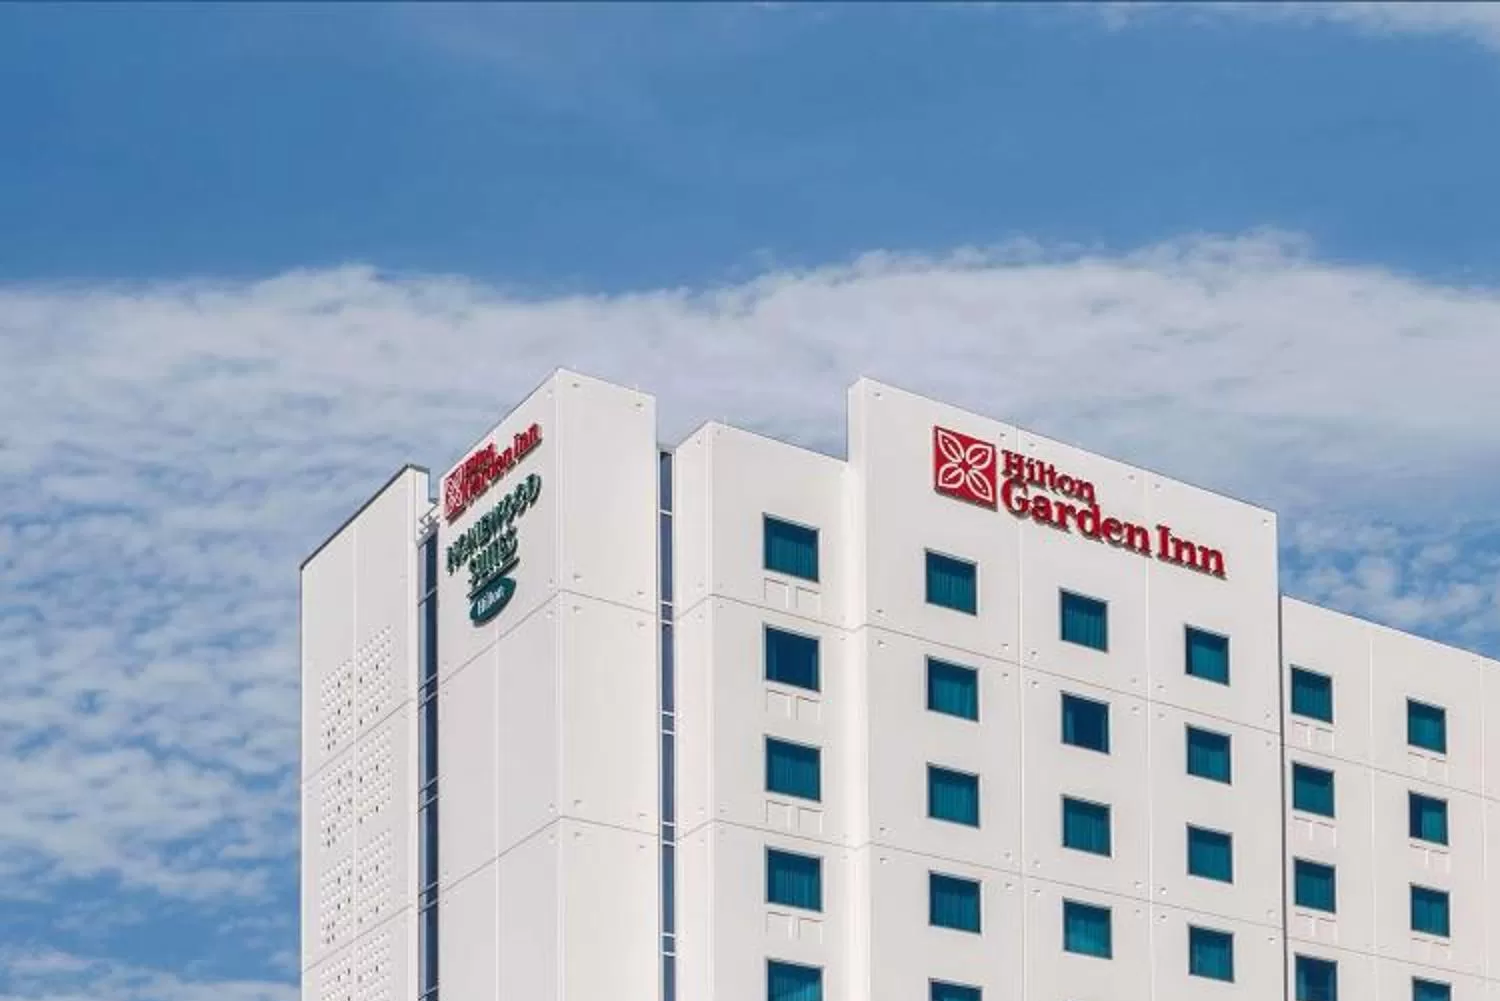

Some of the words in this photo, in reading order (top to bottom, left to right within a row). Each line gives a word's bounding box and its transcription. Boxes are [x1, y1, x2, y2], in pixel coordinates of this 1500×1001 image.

[1000, 450, 1098, 503] Hilton
[1001, 479, 1152, 557] Garden
[1156, 524, 1228, 580] Inn
